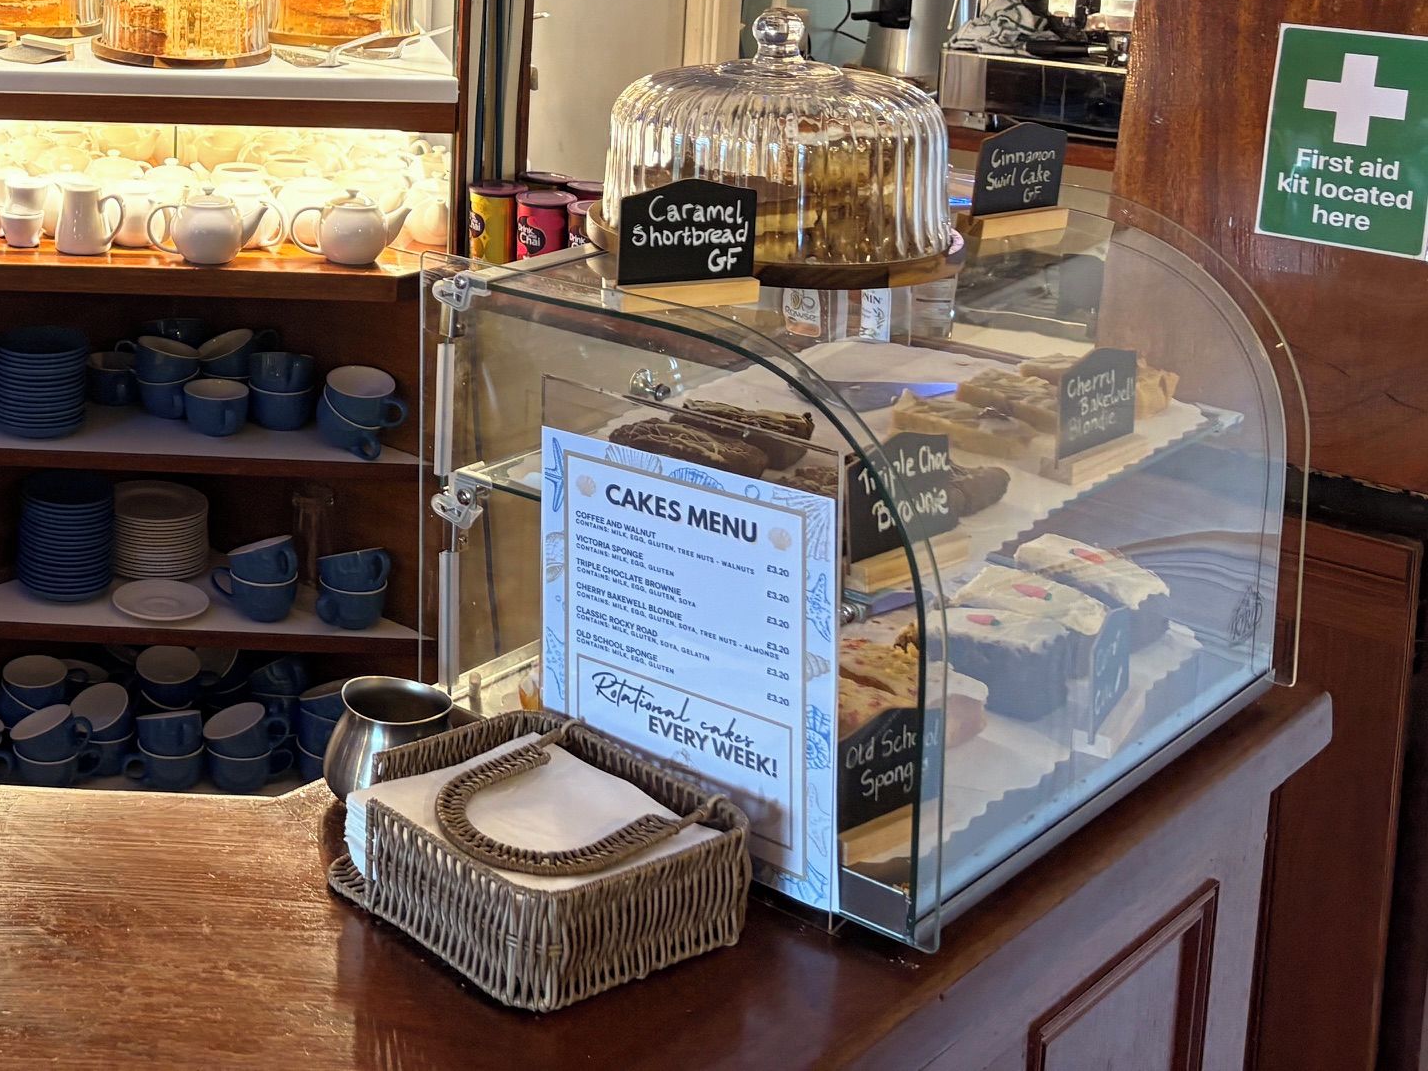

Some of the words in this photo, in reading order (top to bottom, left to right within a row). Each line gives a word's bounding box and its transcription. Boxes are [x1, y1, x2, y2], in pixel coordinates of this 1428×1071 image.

[991, 149, 1055, 168] Cinnamon
[1296, 147, 1353, 175] First
[1359, 158, 1400, 180] aid
[986, 167, 1016, 191] Swirl
[1020, 164, 1050, 185] Cake
[1277, 172, 1310, 195] kit
[1314, 177, 1414, 211] located
[1023, 186, 1042, 203] GF
[649, 195, 744, 224] Caramel
[1312, 204, 1370, 231] here
[520, 233, 541, 247] Chai
[632, 221, 748, 247] Shortbread
[708, 247, 742, 272] GF
[1068, 369, 1115, 399] Cherry
[1080, 377, 1134, 416] Bakewell
[919, 445, 950, 473] Choc
[575, 510, 605, 525] COFFEE
[605, 518, 623, 529] AND
[623, 523, 656, 539] WALNUT
[605, 483, 681, 522] CAKES
[687, 505, 757, 542] MENU
[575, 533, 611, 550] VICTORIA
[611, 544, 644, 560] SPONGE
[575, 557, 601, 571] TRIPLE
[601, 565, 643, 585] CHOCLATE
[644, 578, 681, 596] BROWNIE
[766, 564, 790, 577] £3.20
[575, 581, 606, 596] CHERRY
[606, 590, 647, 610] BAKEWELL
[648, 603, 682, 621] BLONDIE
[766, 590, 790, 603] £3.20
[575, 605, 608, 621] CLASSIC
[608, 615, 636, 631] ROCKY
[636, 623, 659, 638] ROAD
[766, 615, 790, 629] £3.20
[575, 628, 592, 639] OLD
[592, 633, 625, 651] SCHOOL
[625, 645, 658, 662] SPONGE
[766, 641, 790, 655] £3.20
[766, 667, 789, 681] £3.20
[592, 671, 690, 722] Rotational
[700, 718, 754, 748] cakes
[766, 692, 790, 707] £3.20
[648, 714, 709, 751] EVERY
[711, 737, 777, 778] WEEK!
[846, 737, 874, 769] Old
